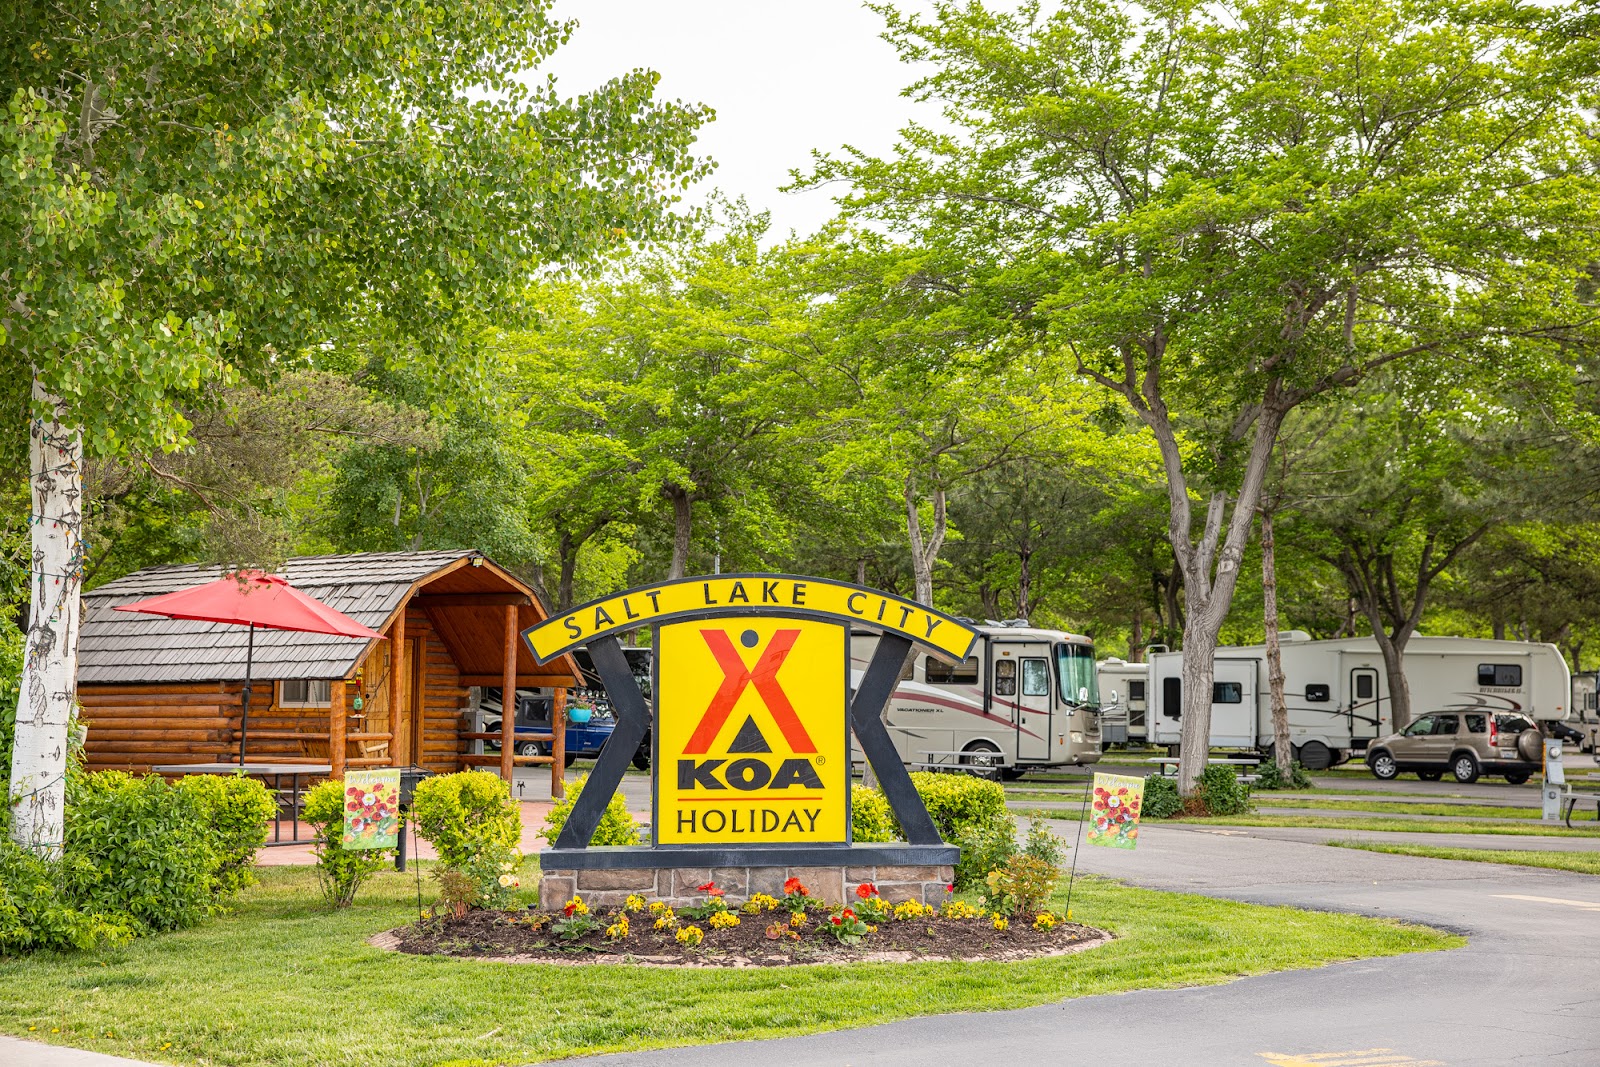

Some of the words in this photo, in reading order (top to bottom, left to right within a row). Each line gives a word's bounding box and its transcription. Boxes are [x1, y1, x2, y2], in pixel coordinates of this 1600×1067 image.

[563, 590, 661, 640] SALT
[704, 581, 807, 605] LAKE
[847, 593, 943, 638] CITY
[350, 773, 396, 785] Welcome
[677, 758, 826, 791] KOA
[677, 808, 822, 834] HOLIDAY
